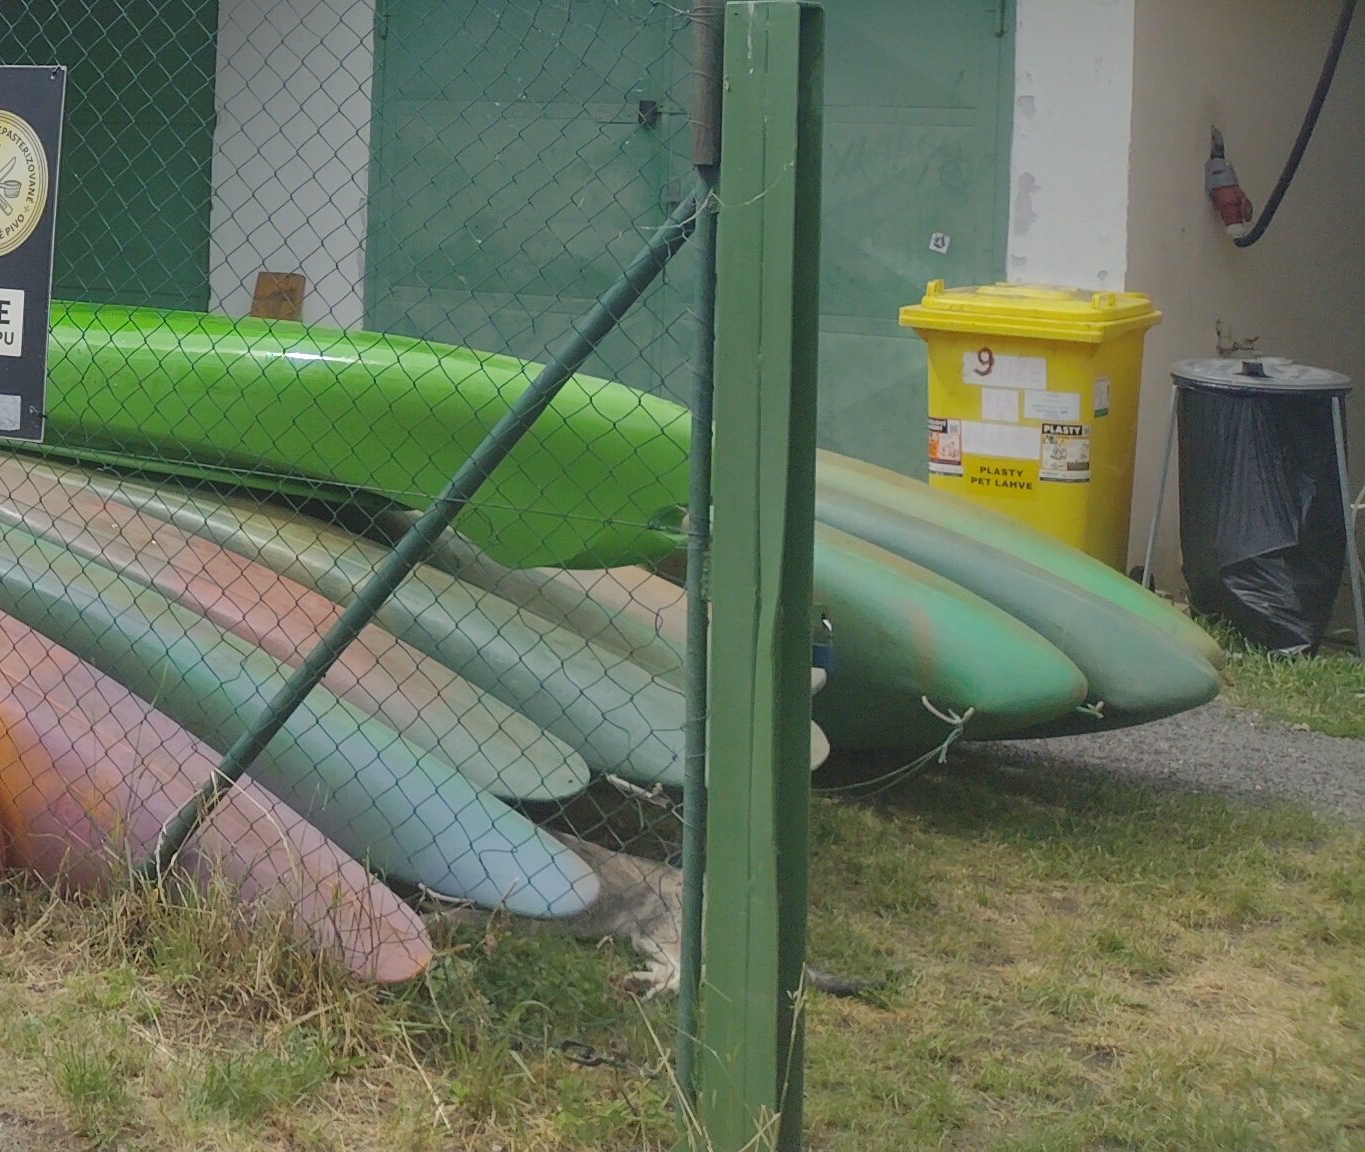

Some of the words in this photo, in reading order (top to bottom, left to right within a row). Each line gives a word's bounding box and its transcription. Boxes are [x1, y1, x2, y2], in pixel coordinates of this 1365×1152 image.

[5, 214, 25, 236] PIVO
[973, 347, 995, 376] 9
[1043, 424, 1081, 436] PLASTY
[979, 466, 1024, 478] PLASTY
[971, 477, 991, 486] PET
[995, 480, 1033, 490] LAHVE
